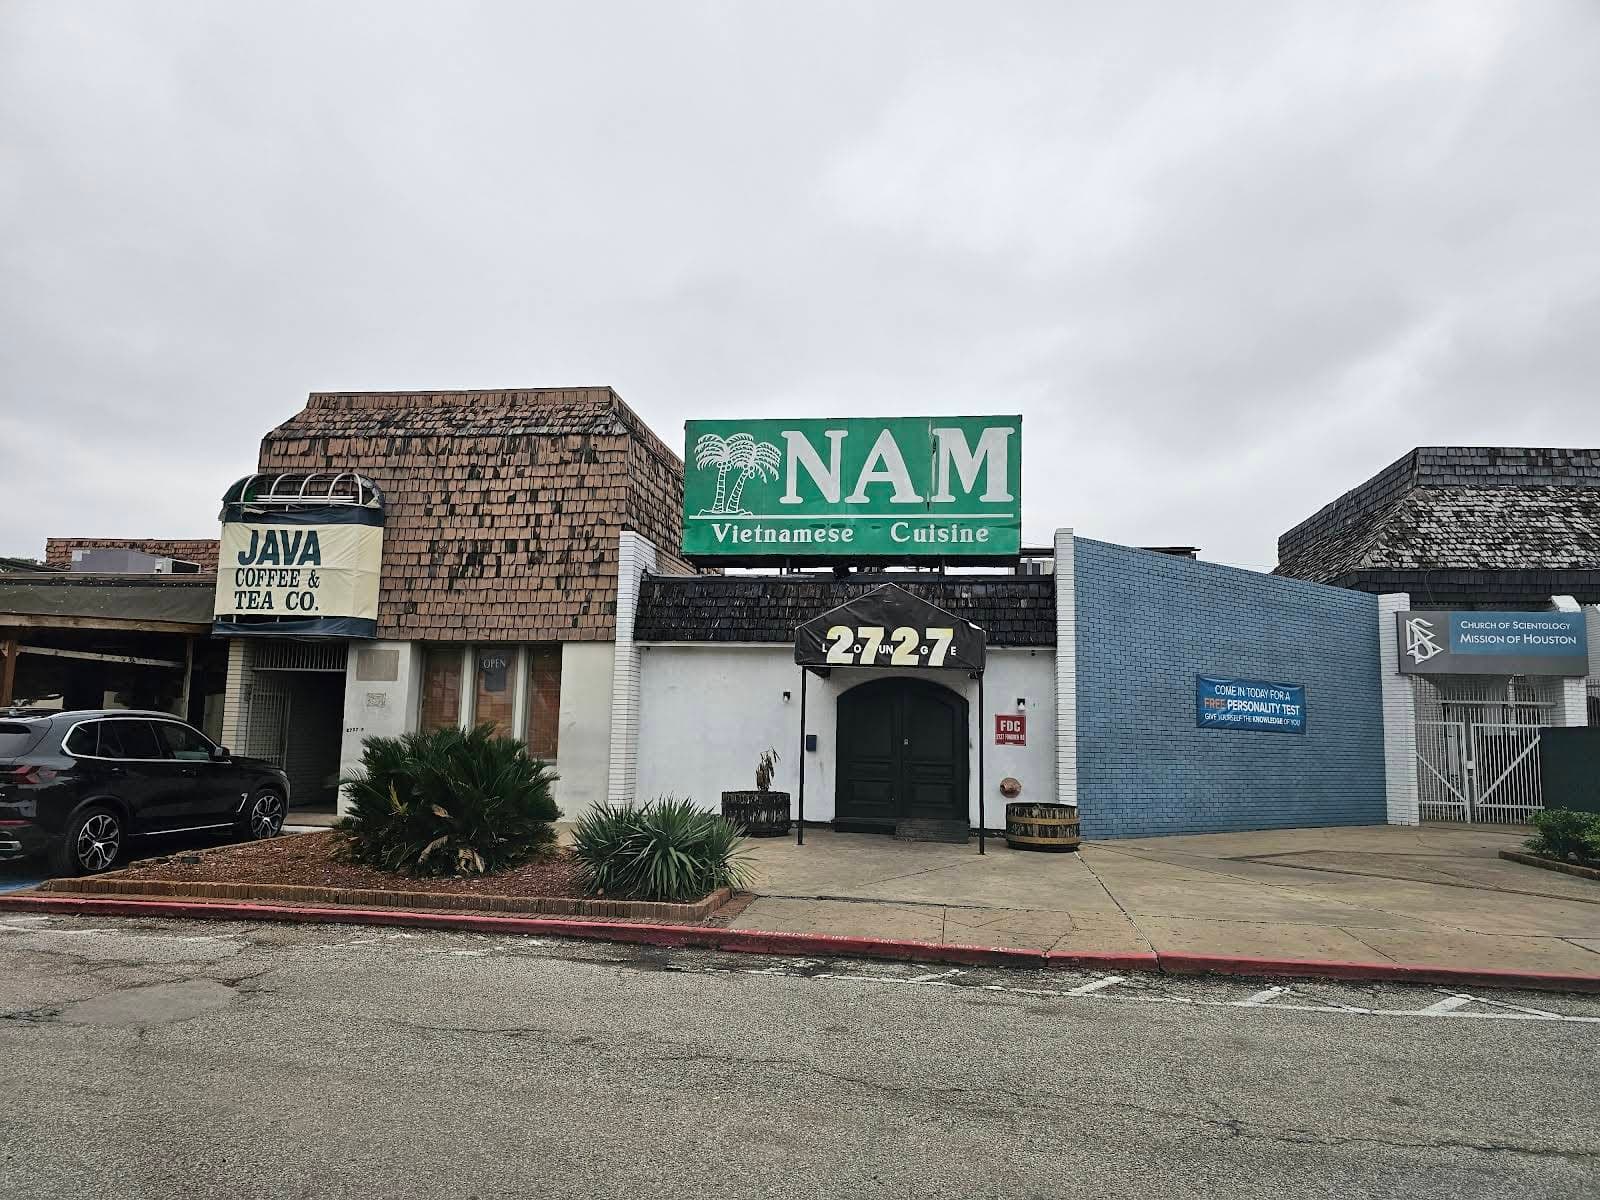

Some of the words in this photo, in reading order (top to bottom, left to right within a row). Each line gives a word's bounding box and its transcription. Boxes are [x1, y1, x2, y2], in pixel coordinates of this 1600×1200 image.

[779, 427, 1016, 504] NAM
[711, 523, 854, 544] Vietnamese
[890, 521, 989, 544] Cuisine
[237, 529, 322, 566] JAVA
[235, 567, 300, 588] COFFEE
[307, 569, 320, 589] &
[234, 590, 275, 610] TEA
[285, 590, 319, 611] CO.
[1460, 620, 1497, 630] CHURCH
[1498, 621, 1511, 630] OF
[1512, 621, 1571, 631] SCIENTOLOGY
[826, 625, 954, 667] 2727
[1460, 633, 1505, 645] MISSION
[1506, 635, 1521, 645] OF
[1523, 633, 1577, 645] HOUSTON
[483, 658, 506, 669] OPEN
[1214, 684, 1237, 697] COME
[1237, 686, 1246, 697] IN
[1246, 687, 1269, 699] TODAY
[1270, 689, 1284, 700] FOR
[1284, 691, 1291, 701] A
[1204, 697, 1227, 710] FREE
[1226, 699, 1281, 714] PERSONALITY
[1281, 703, 1301, 716] TEST
[1000, 719, 1021, 733] FDC
[1204, 712, 1217, 721] GIVE
[1217, 713, 1242, 722] YOURSELF
[1242, 715, 1252, 723] THE
[1252, 715, 1284, 725] KNOWLEDGE
[1290, 719, 1301, 727] YOU
